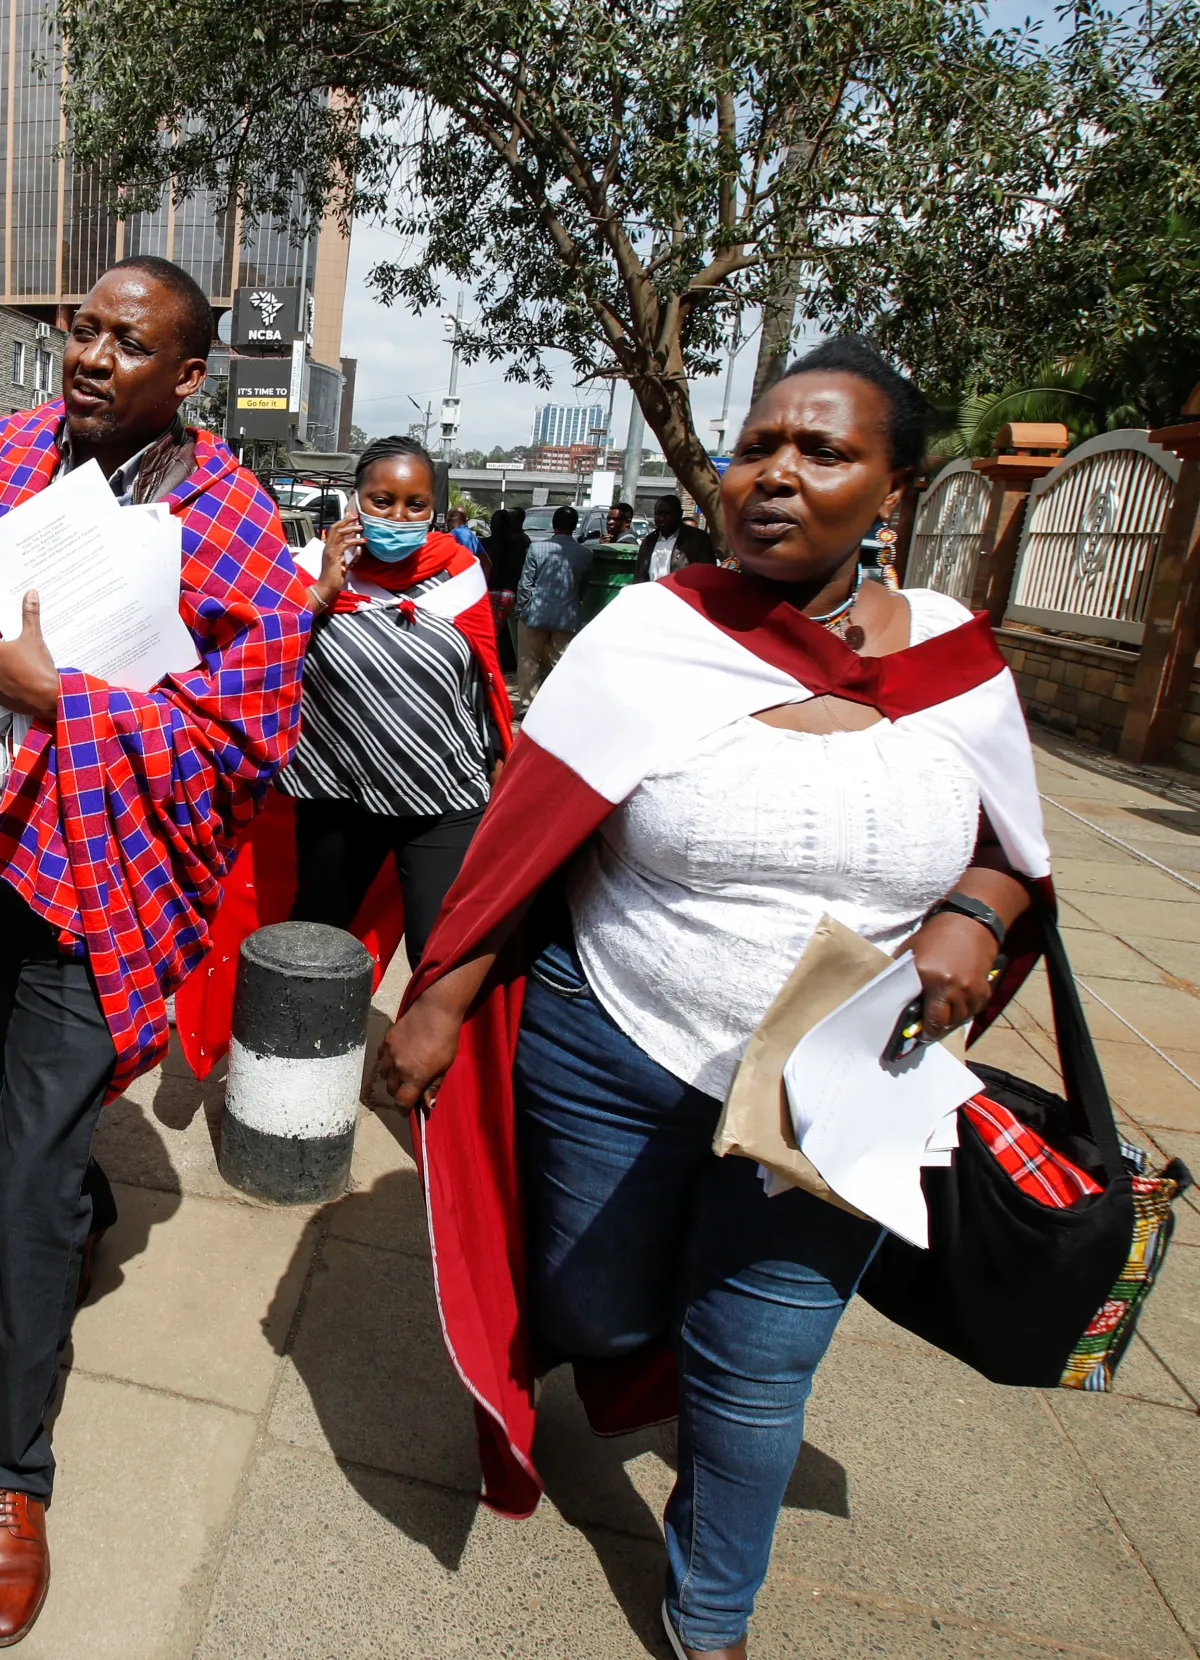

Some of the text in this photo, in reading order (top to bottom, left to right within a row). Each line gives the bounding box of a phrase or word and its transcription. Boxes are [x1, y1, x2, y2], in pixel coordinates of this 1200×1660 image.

[248, 330, 282, 340] NCBA
[238, 387, 287, 396] IT'S TIME TO
